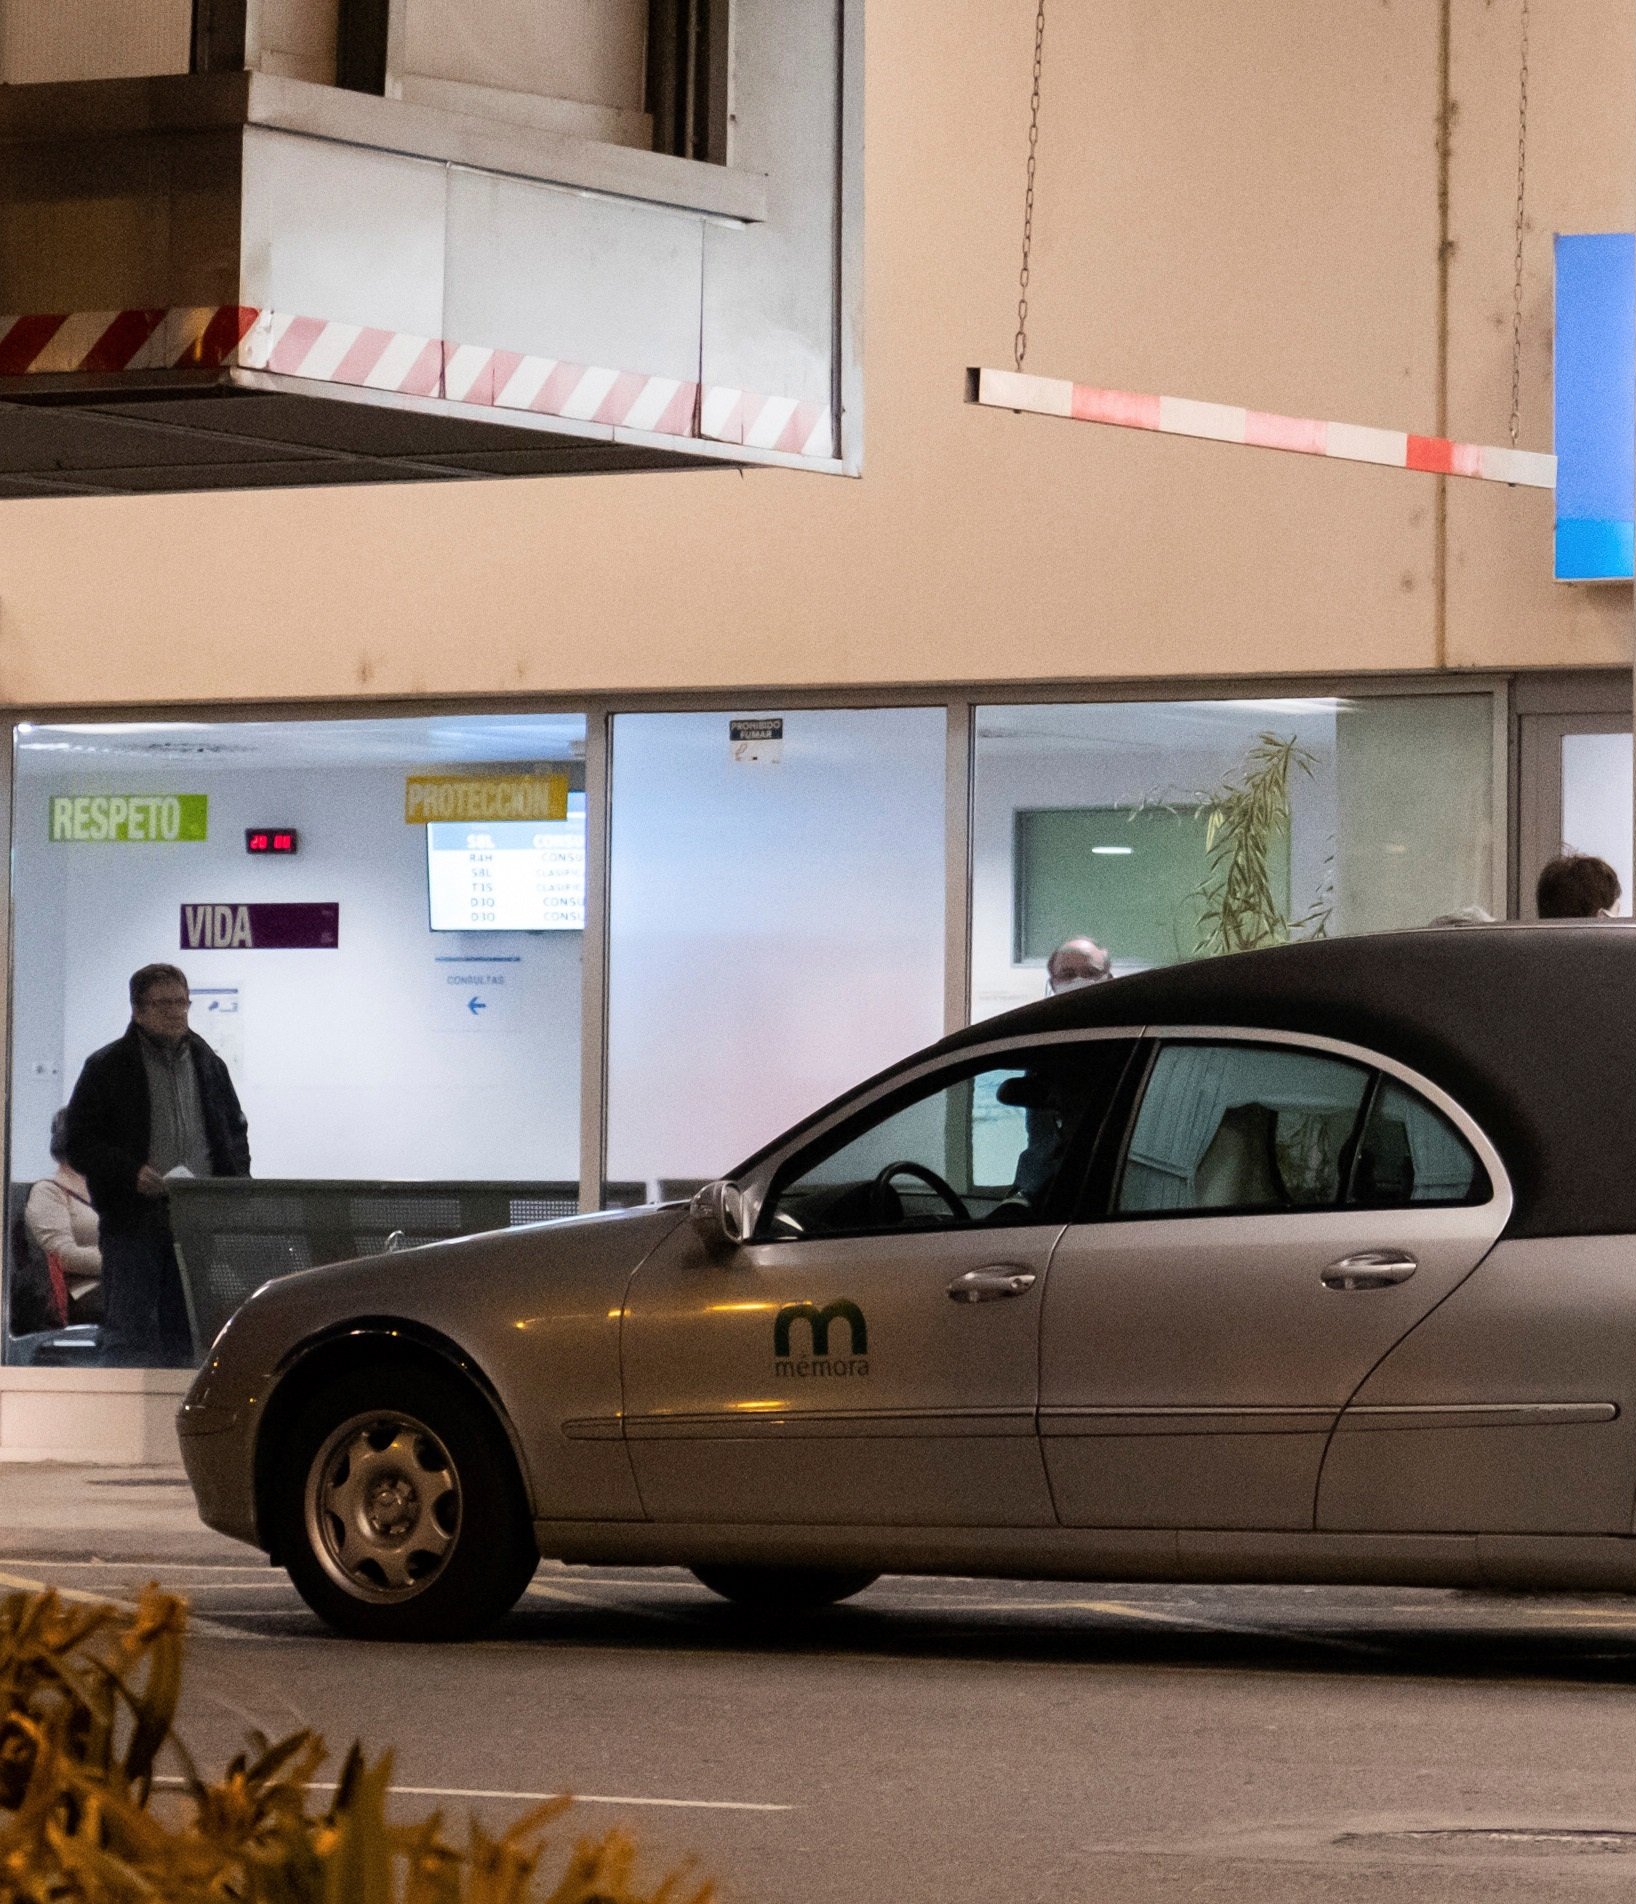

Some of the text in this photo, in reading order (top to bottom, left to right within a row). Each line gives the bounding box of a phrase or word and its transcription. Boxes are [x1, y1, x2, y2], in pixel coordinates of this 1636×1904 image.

[407, 775, 550, 817] PROTECCIÓN
[53, 796, 181, 840] RESPETO
[184, 905, 253, 948] VIDA
